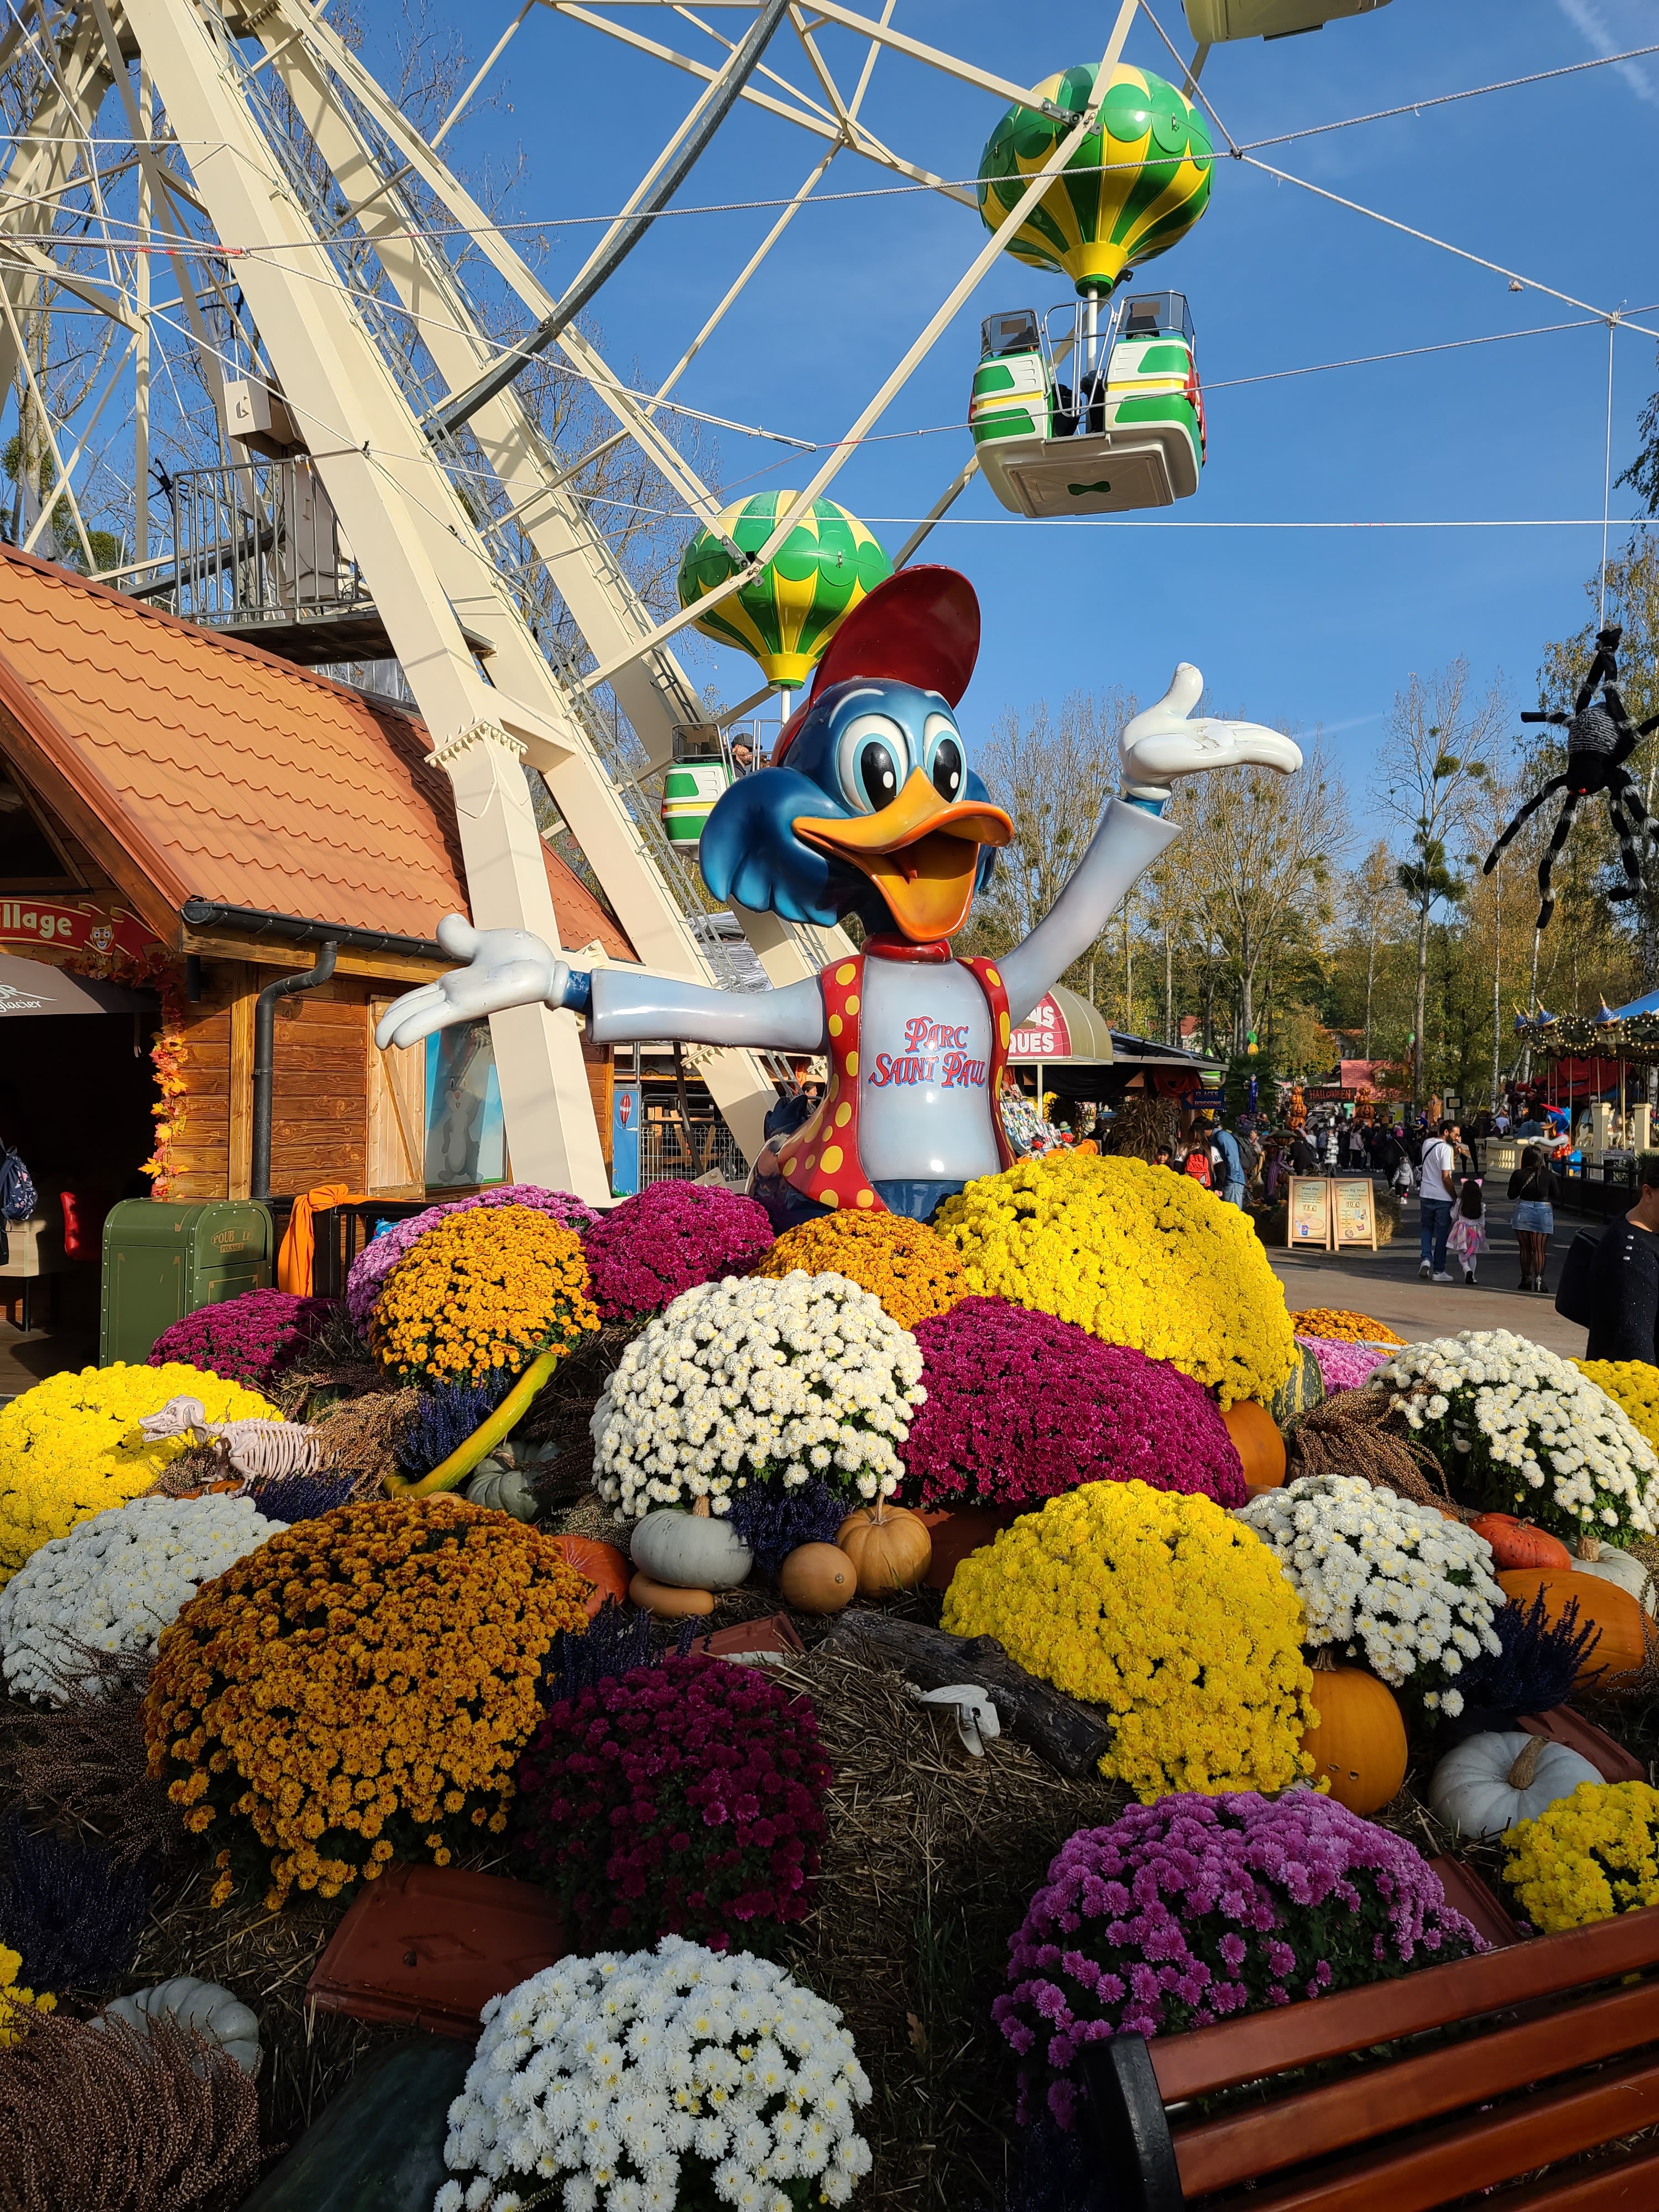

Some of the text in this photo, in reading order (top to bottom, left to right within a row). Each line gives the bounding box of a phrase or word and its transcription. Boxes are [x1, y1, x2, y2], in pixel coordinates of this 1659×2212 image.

[905, 1016, 969, 1054] PARC
[868, 1051, 986, 1088] SAINT PAUL
[1309, 1089, 1352, 1100] HALLOWEEN
